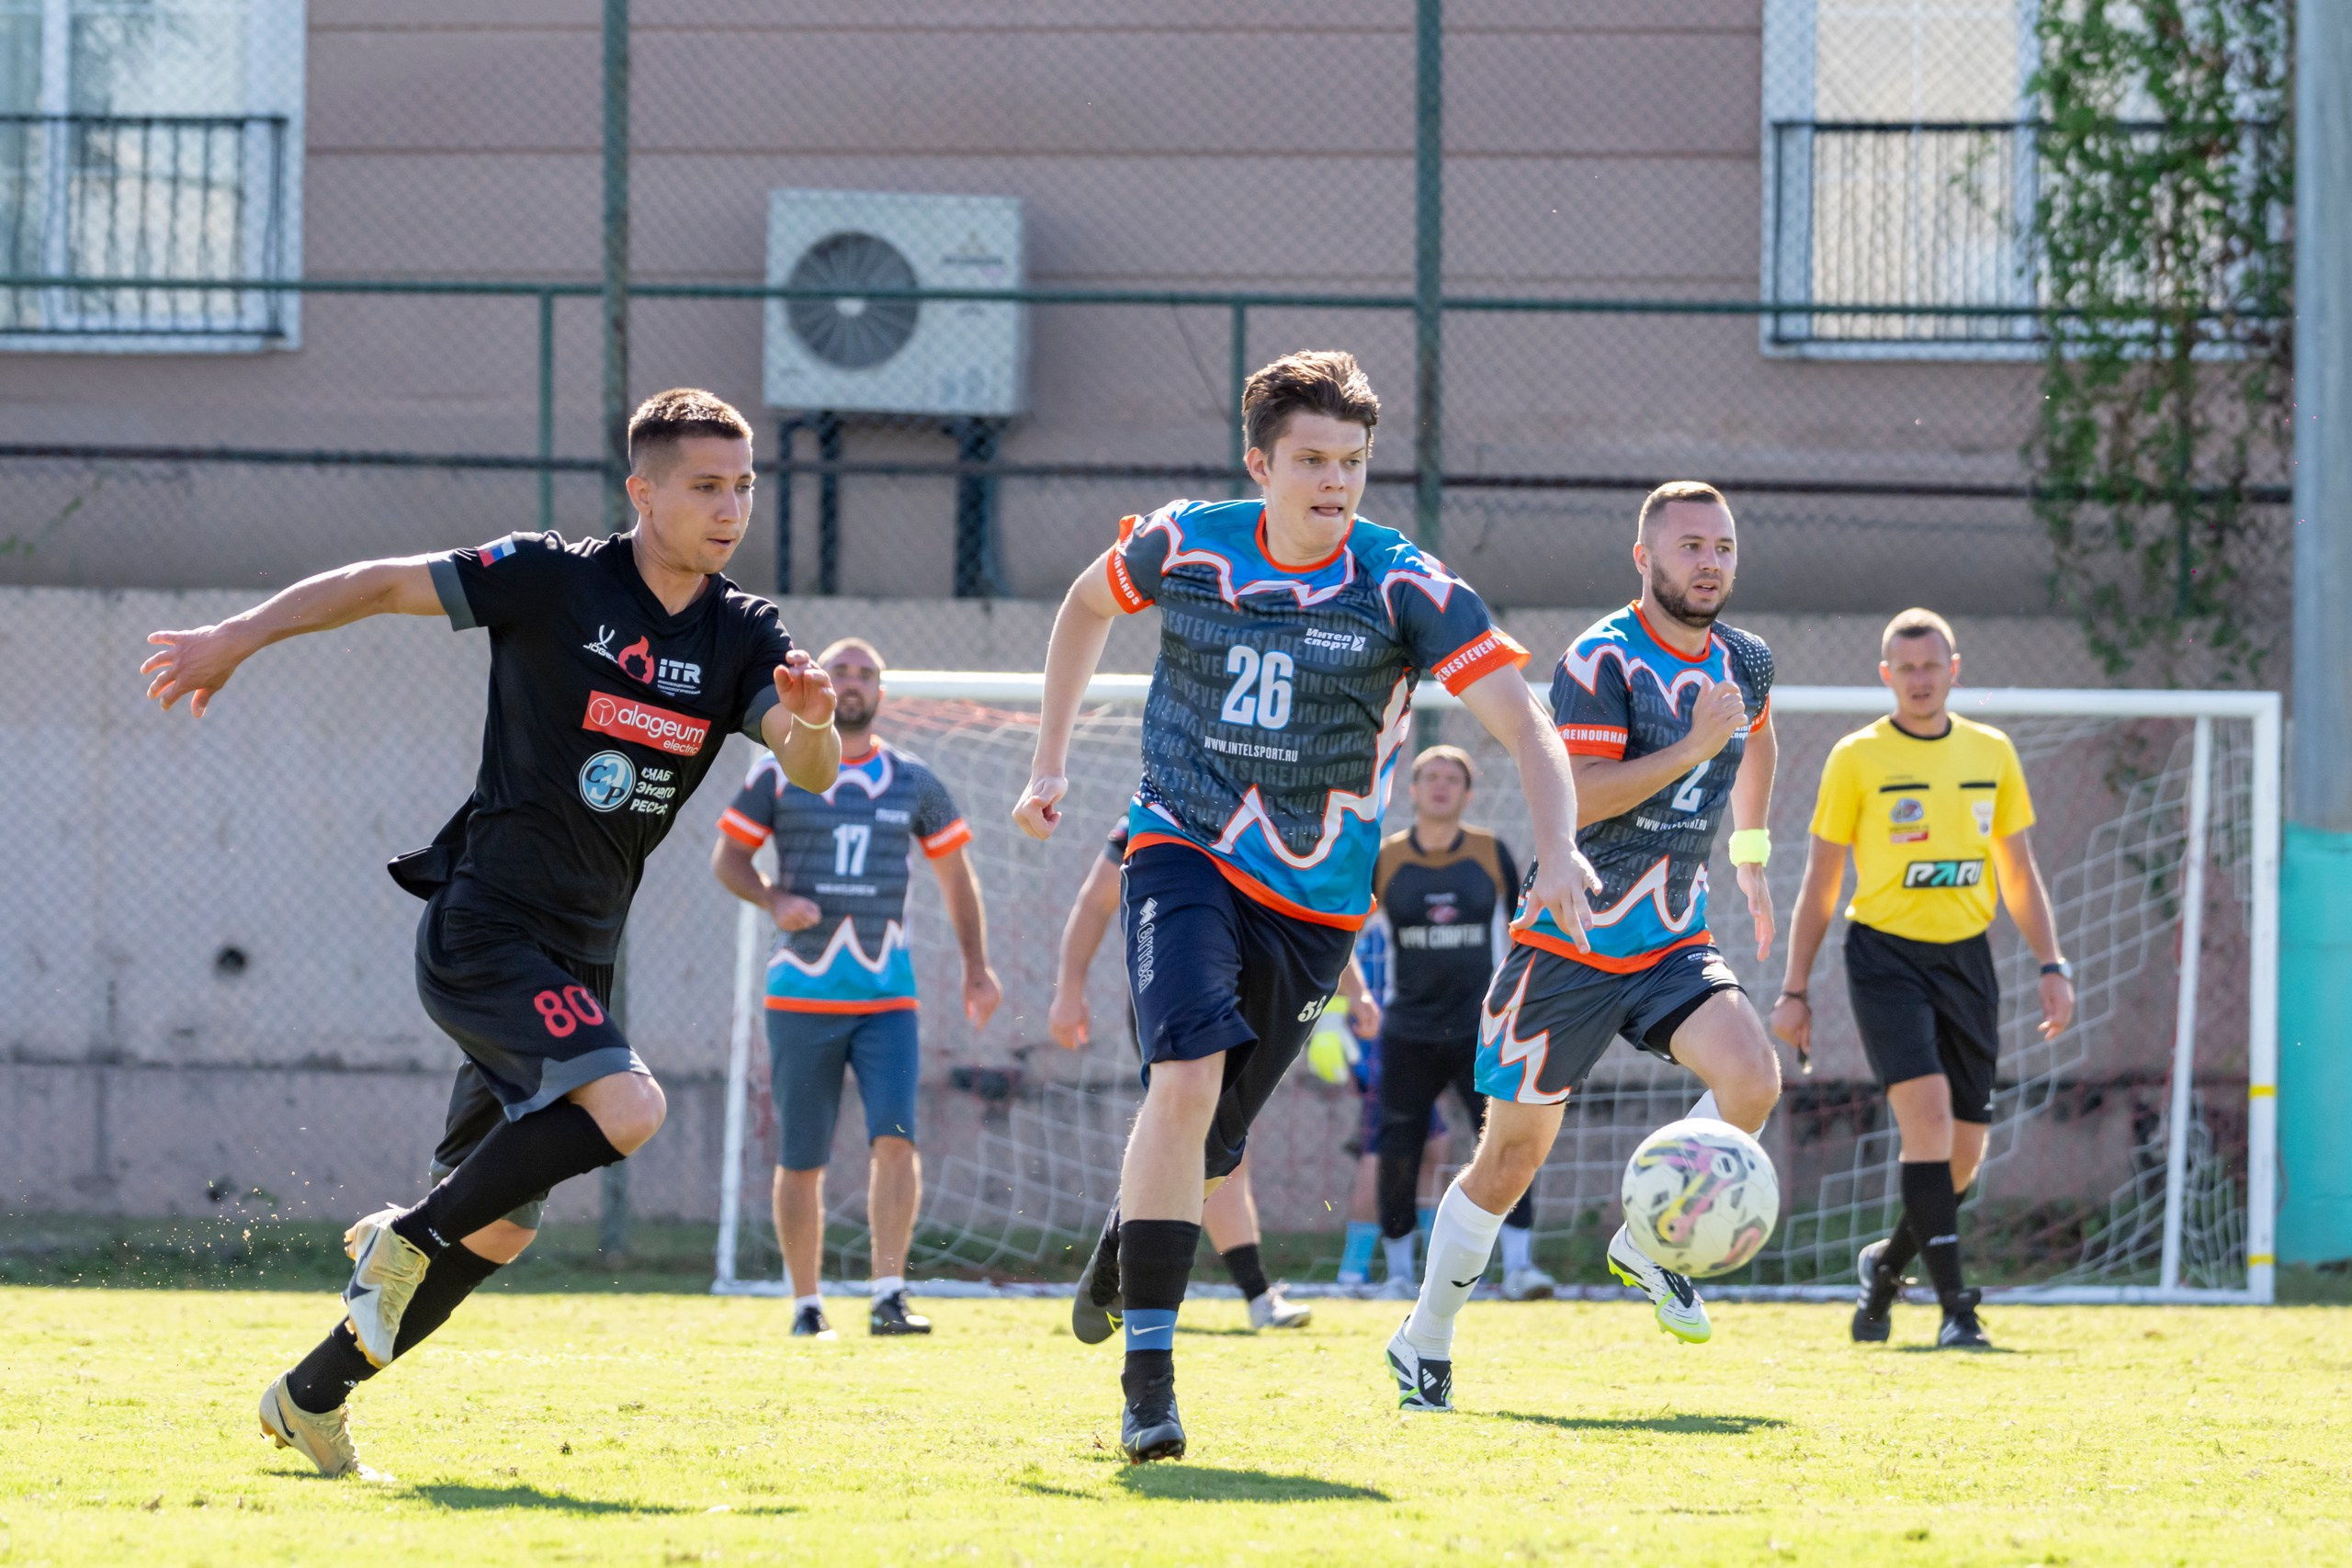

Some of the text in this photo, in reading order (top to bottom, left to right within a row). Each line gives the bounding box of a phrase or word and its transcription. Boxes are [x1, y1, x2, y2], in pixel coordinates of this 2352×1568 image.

[1304, 637, 1349, 650] спорт
[1306, 627, 1352, 642] Интел
[1220, 645, 1294, 730] 26
[617, 705, 705, 744] alageum
[663, 739, 699, 754] electric
[1204, 735, 1298, 762] WWW.INTELSPORT.RU
[641, 766, 673, 782] СНАБ
[832, 823, 872, 877] 17
[534, 985, 604, 1038] 80
